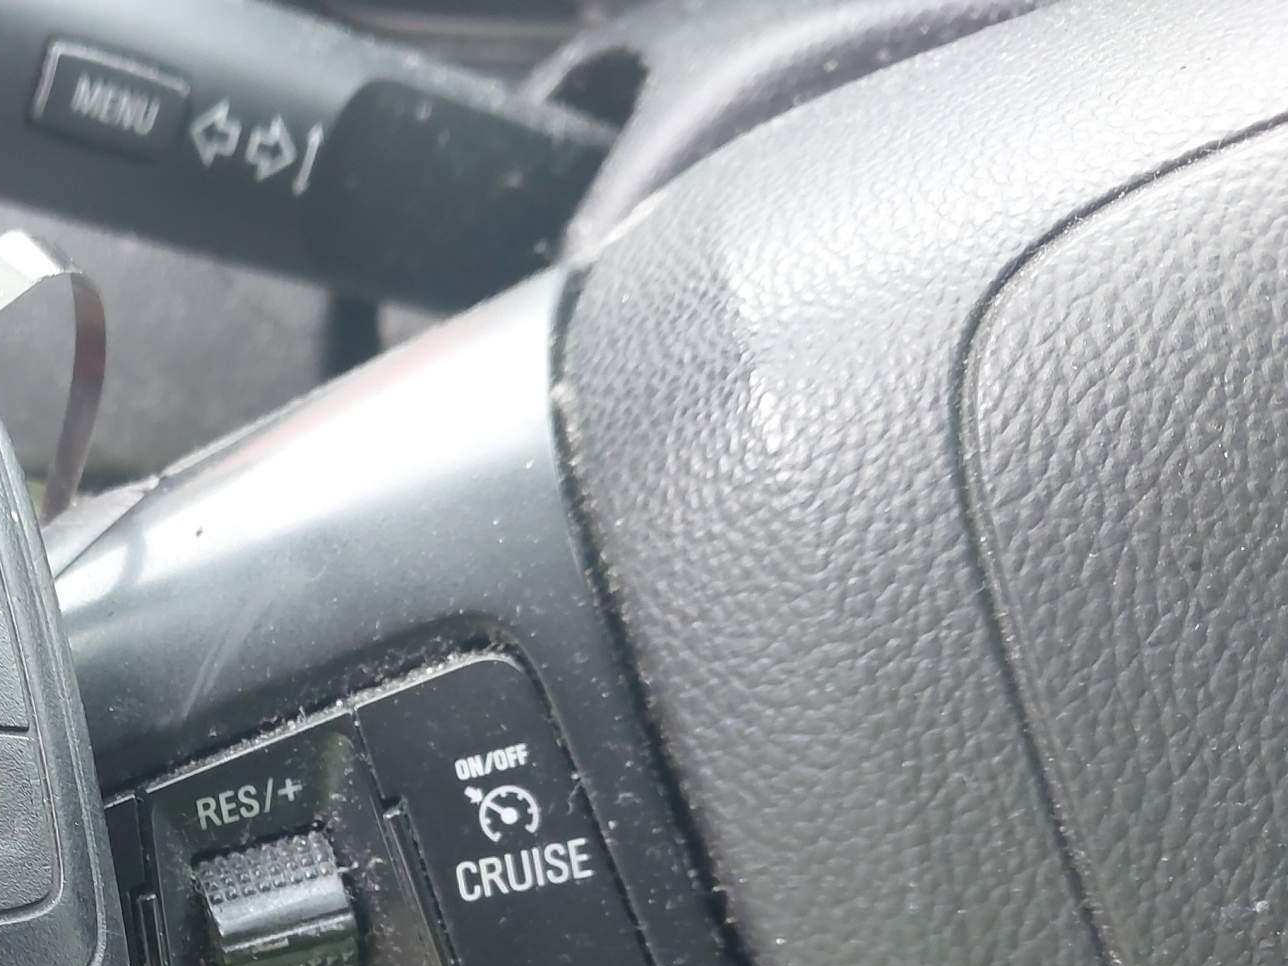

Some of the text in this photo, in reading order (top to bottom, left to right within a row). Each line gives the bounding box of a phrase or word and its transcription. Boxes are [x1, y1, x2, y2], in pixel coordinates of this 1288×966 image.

[70, 73, 161, 136] MENU
[454, 743, 530, 782] ON/OFF
[195, 776, 304, 831] RES/+
[456, 837, 595, 903] CRUISE
